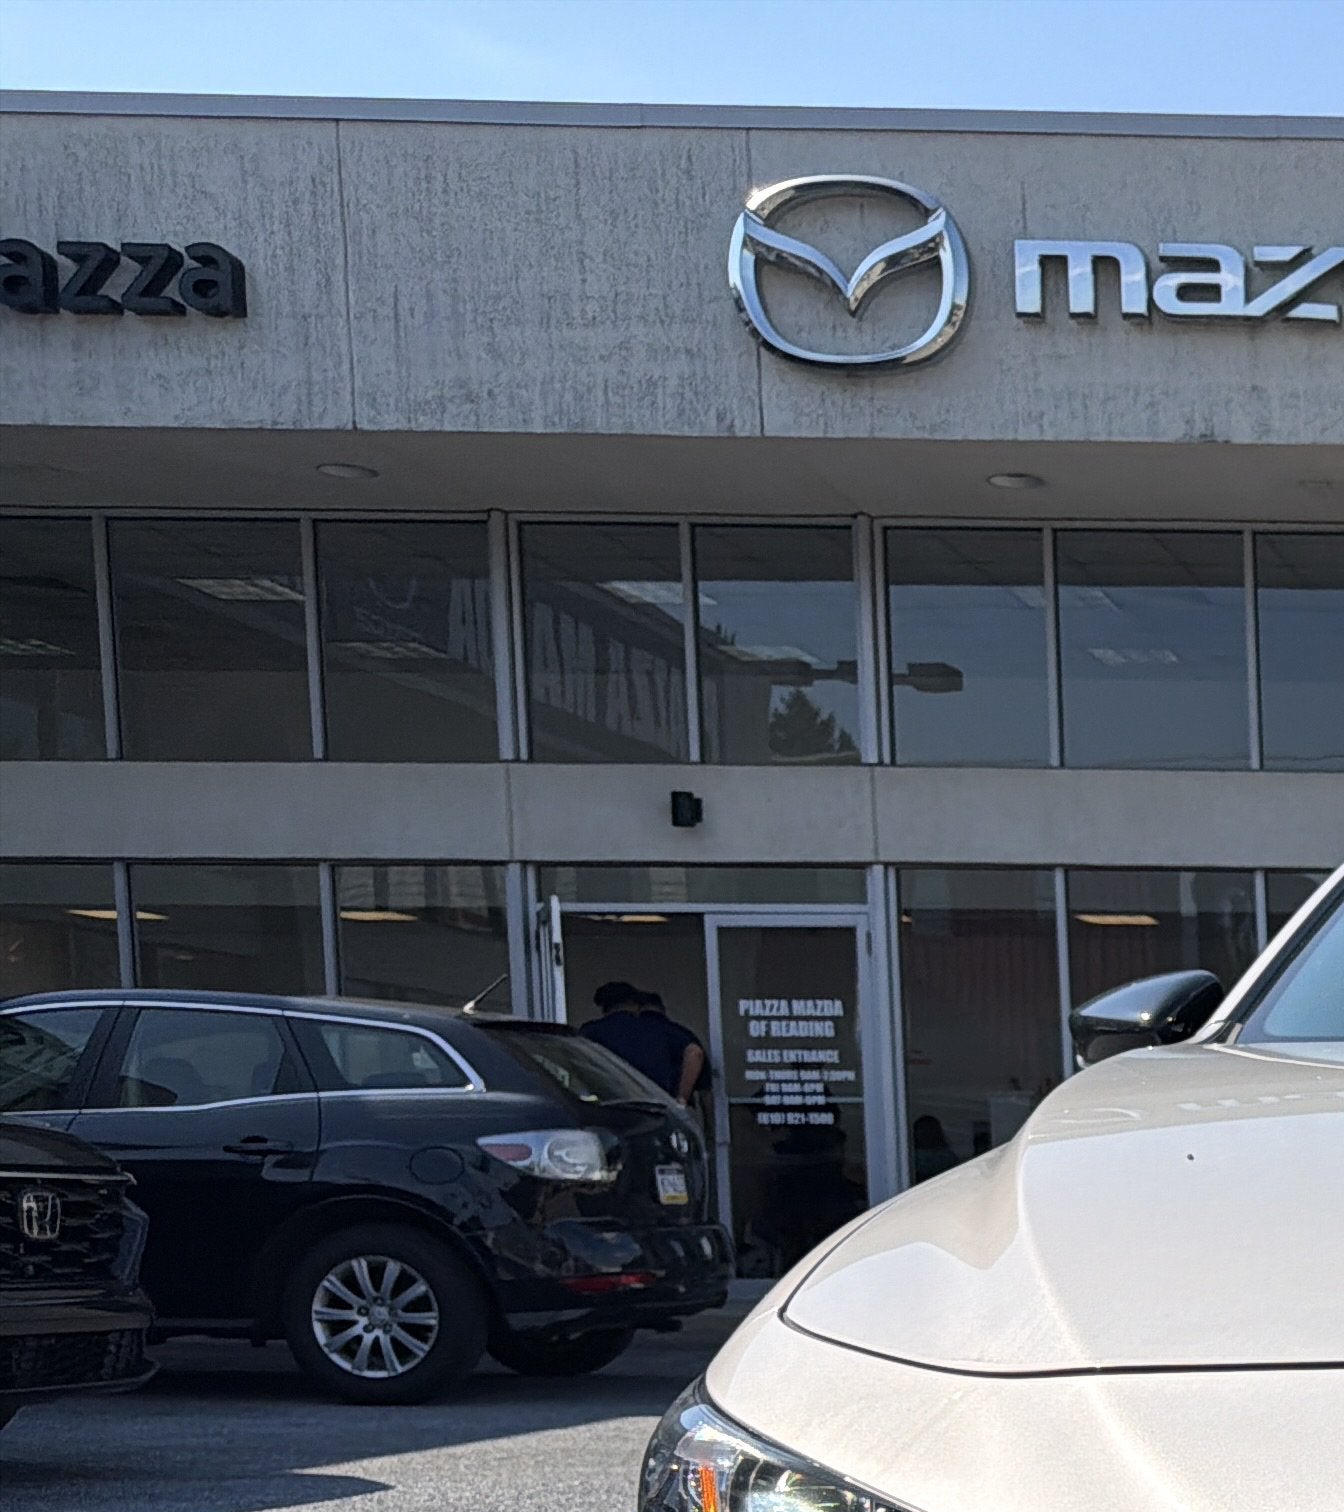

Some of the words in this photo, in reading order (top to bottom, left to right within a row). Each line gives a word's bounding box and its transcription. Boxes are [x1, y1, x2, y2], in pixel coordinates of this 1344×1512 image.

[739, 999, 789, 1016] PIAZZA
[791, 999, 844, 1016] MAZDA
[749, 1020, 766, 1037] OF
[771, 1020, 835, 1037] READING
[782, 1049, 840, 1063] ENTRANCE
